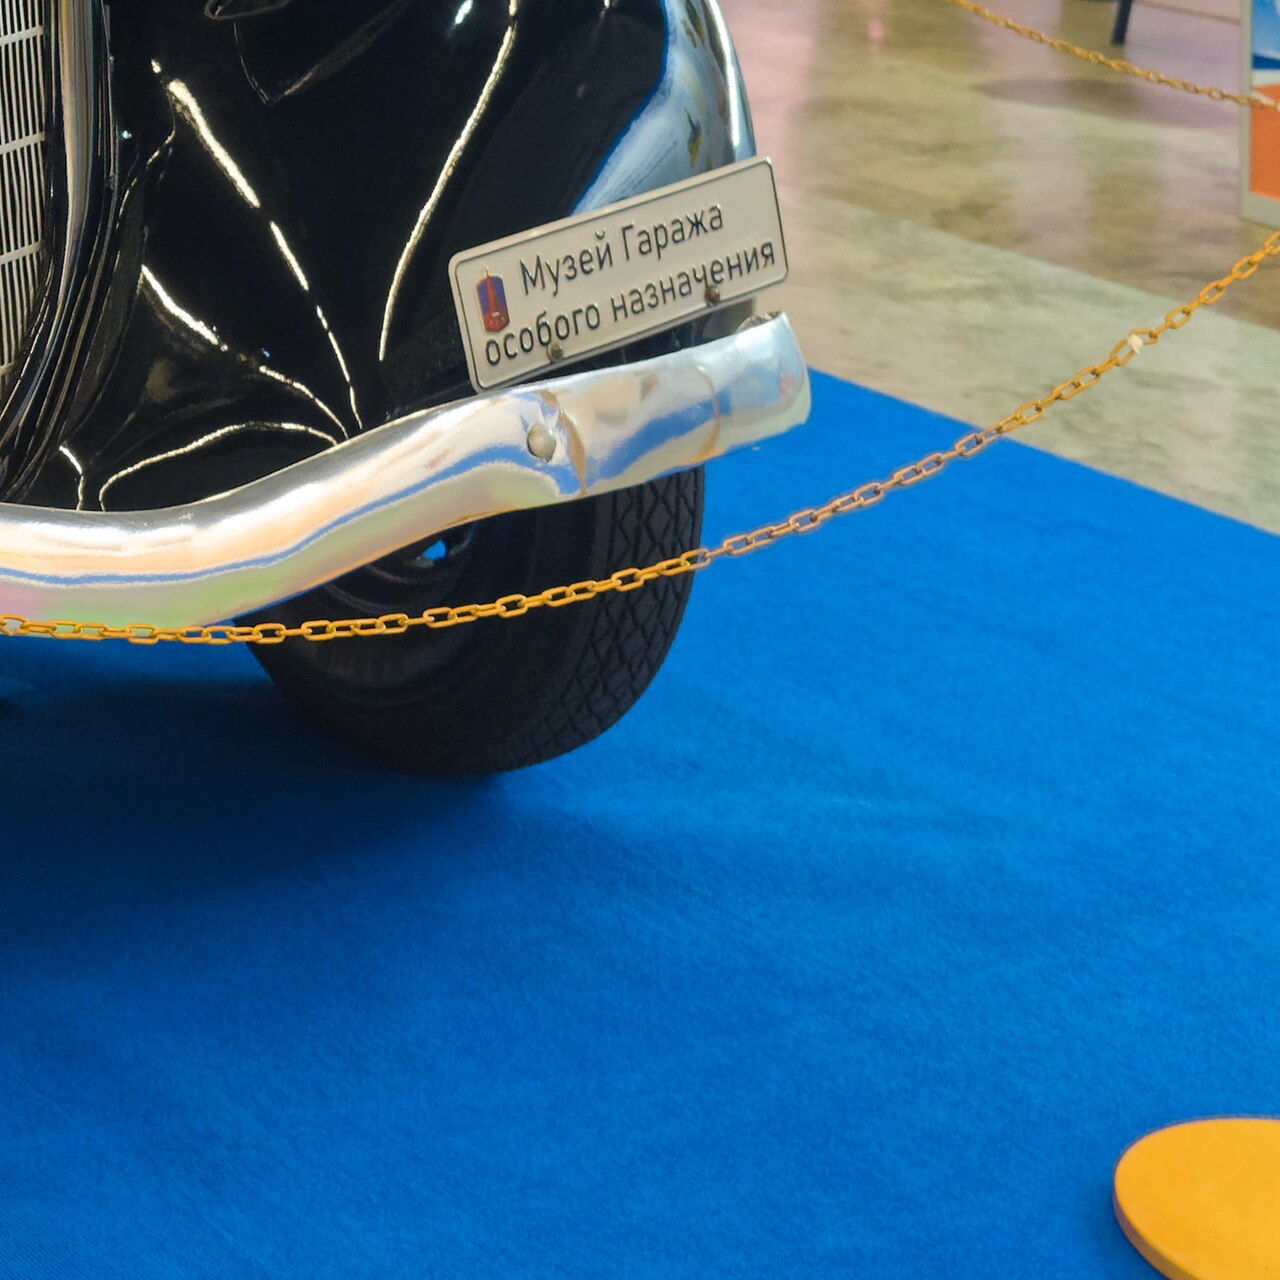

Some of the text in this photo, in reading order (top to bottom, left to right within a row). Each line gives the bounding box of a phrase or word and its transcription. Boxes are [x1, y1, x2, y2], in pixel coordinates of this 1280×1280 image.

[484, 240, 776, 367] особого назначения
[519, 202, 725, 297] Музей Гаража
